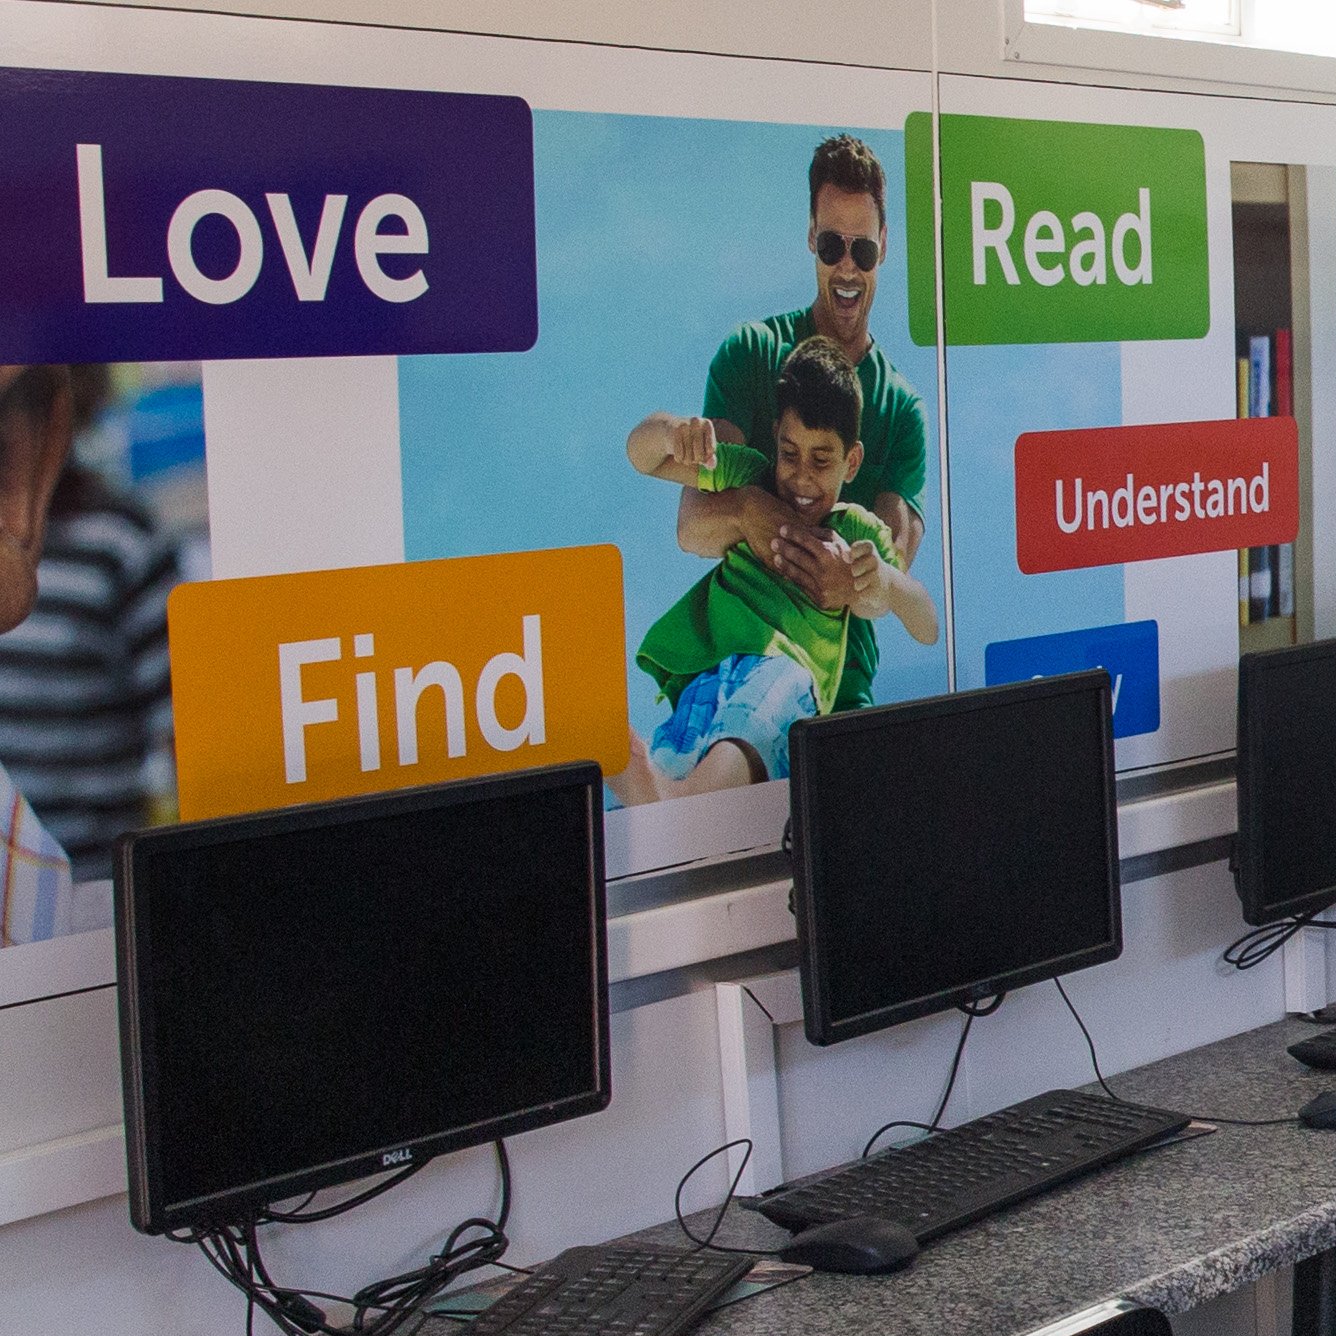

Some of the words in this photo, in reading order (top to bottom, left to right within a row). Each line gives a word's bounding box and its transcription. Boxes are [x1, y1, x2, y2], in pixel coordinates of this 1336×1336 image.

[75, 143, 430, 305] Love
[969, 181, 1154, 288] Read
[1054, 462, 1271, 535] Understand
[277, 613, 547, 785] Find
[382, 1147, 413, 1167] DELL
